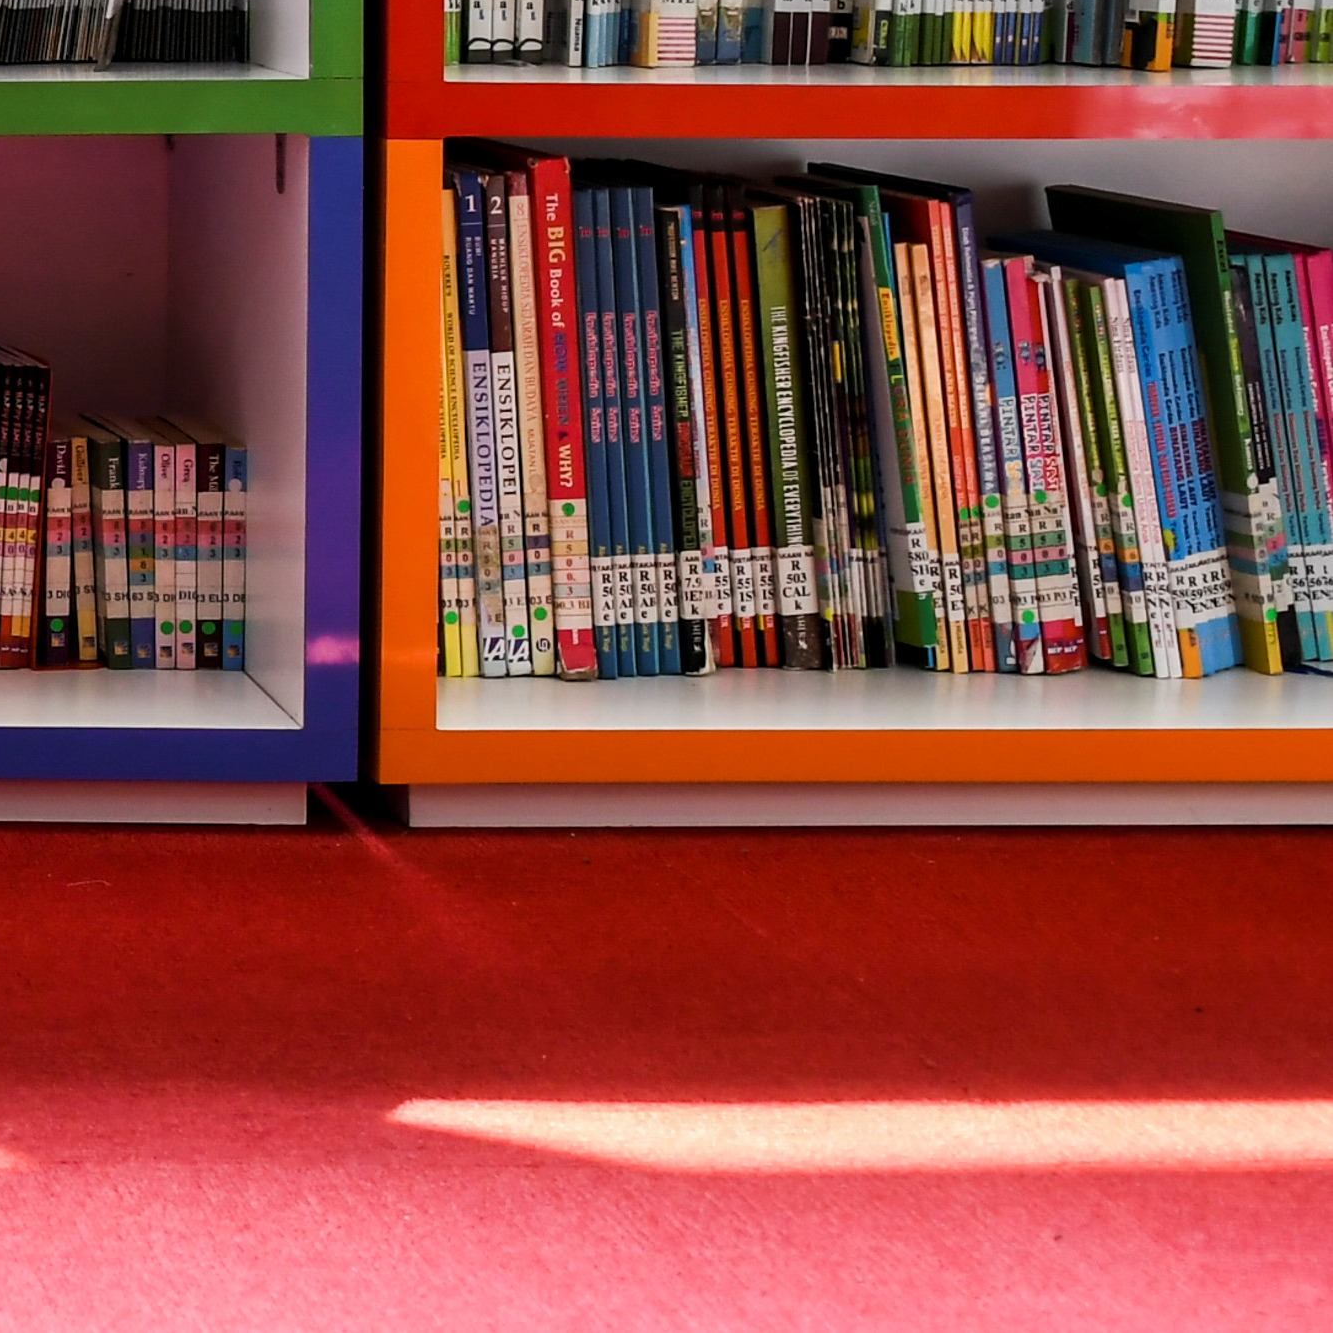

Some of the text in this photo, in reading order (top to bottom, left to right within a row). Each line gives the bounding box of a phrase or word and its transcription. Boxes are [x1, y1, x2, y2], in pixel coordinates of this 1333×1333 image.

[465, 195, 477, 213] 1
[490, 196, 503, 214] 2
[546, 193, 559, 221] The
[547, 226, 566, 263] BIG
[549, 269, 564, 307] Book
[552, 311, 565, 328] of
[770, 306, 787, 324] THE
[772, 325, 792, 389] KINGFISHER
[777, 389, 798, 469] ENCYCLOPEDIA
[1001, 398, 1018, 459] PINTAR
[1023, 395, 1040, 452] PINTAR
[473, 362, 494, 526] ENSIKLOPEDIA
[56, 445, 67, 475] David
[160, 453, 171, 479] Olive
[559, 444, 574, 488] WHY?
[783, 470, 799, 483] OF
[786, 572, 807, 584] 503
[791, 560, 801, 571] R
[782, 586, 811, 597] CAL
